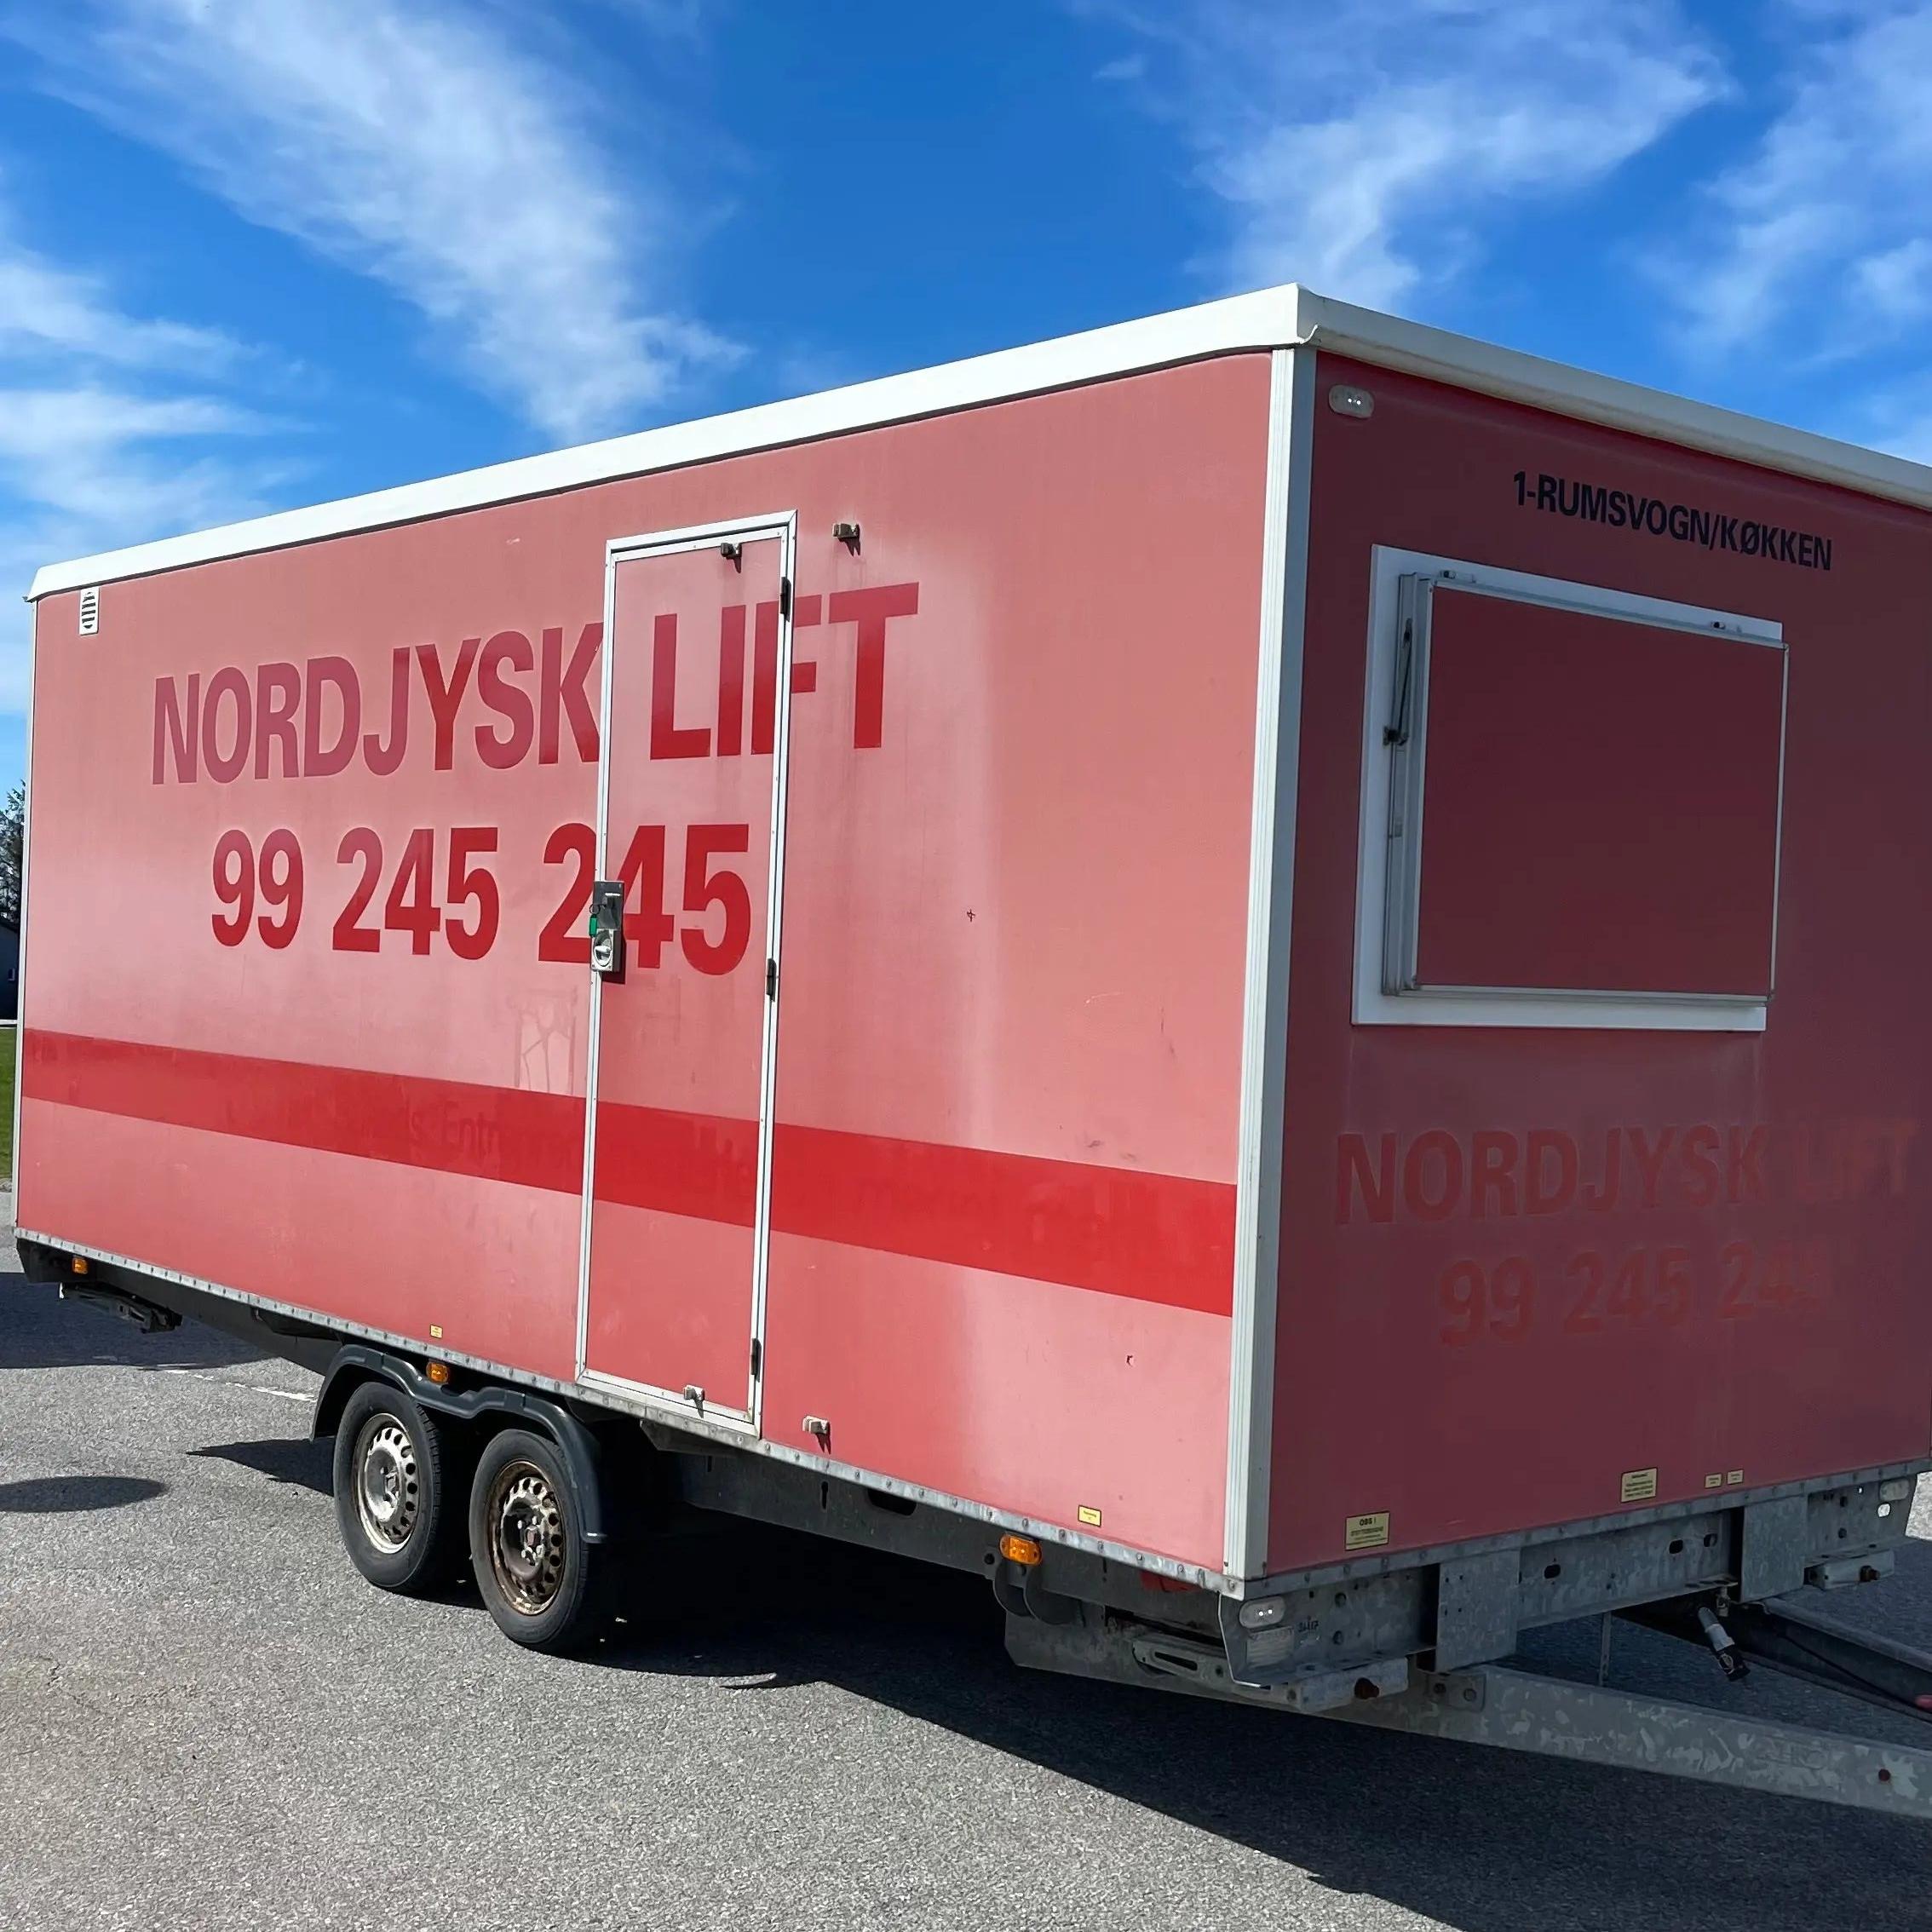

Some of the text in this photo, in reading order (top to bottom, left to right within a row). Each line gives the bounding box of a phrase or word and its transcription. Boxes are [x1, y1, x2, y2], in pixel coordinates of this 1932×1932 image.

[1513, 471, 1832, 571] 1-RUMSVOGN/KØKKEN
[153, 583, 919, 785] NORDJYSK LIFT
[211, 824, 751, 976] 99 245 245
[1337, 1124, 1769, 1224] NORDJYSK
[1440, 1256, 1534, 1347] 99
[1566, 1247, 1689, 1335] 245
